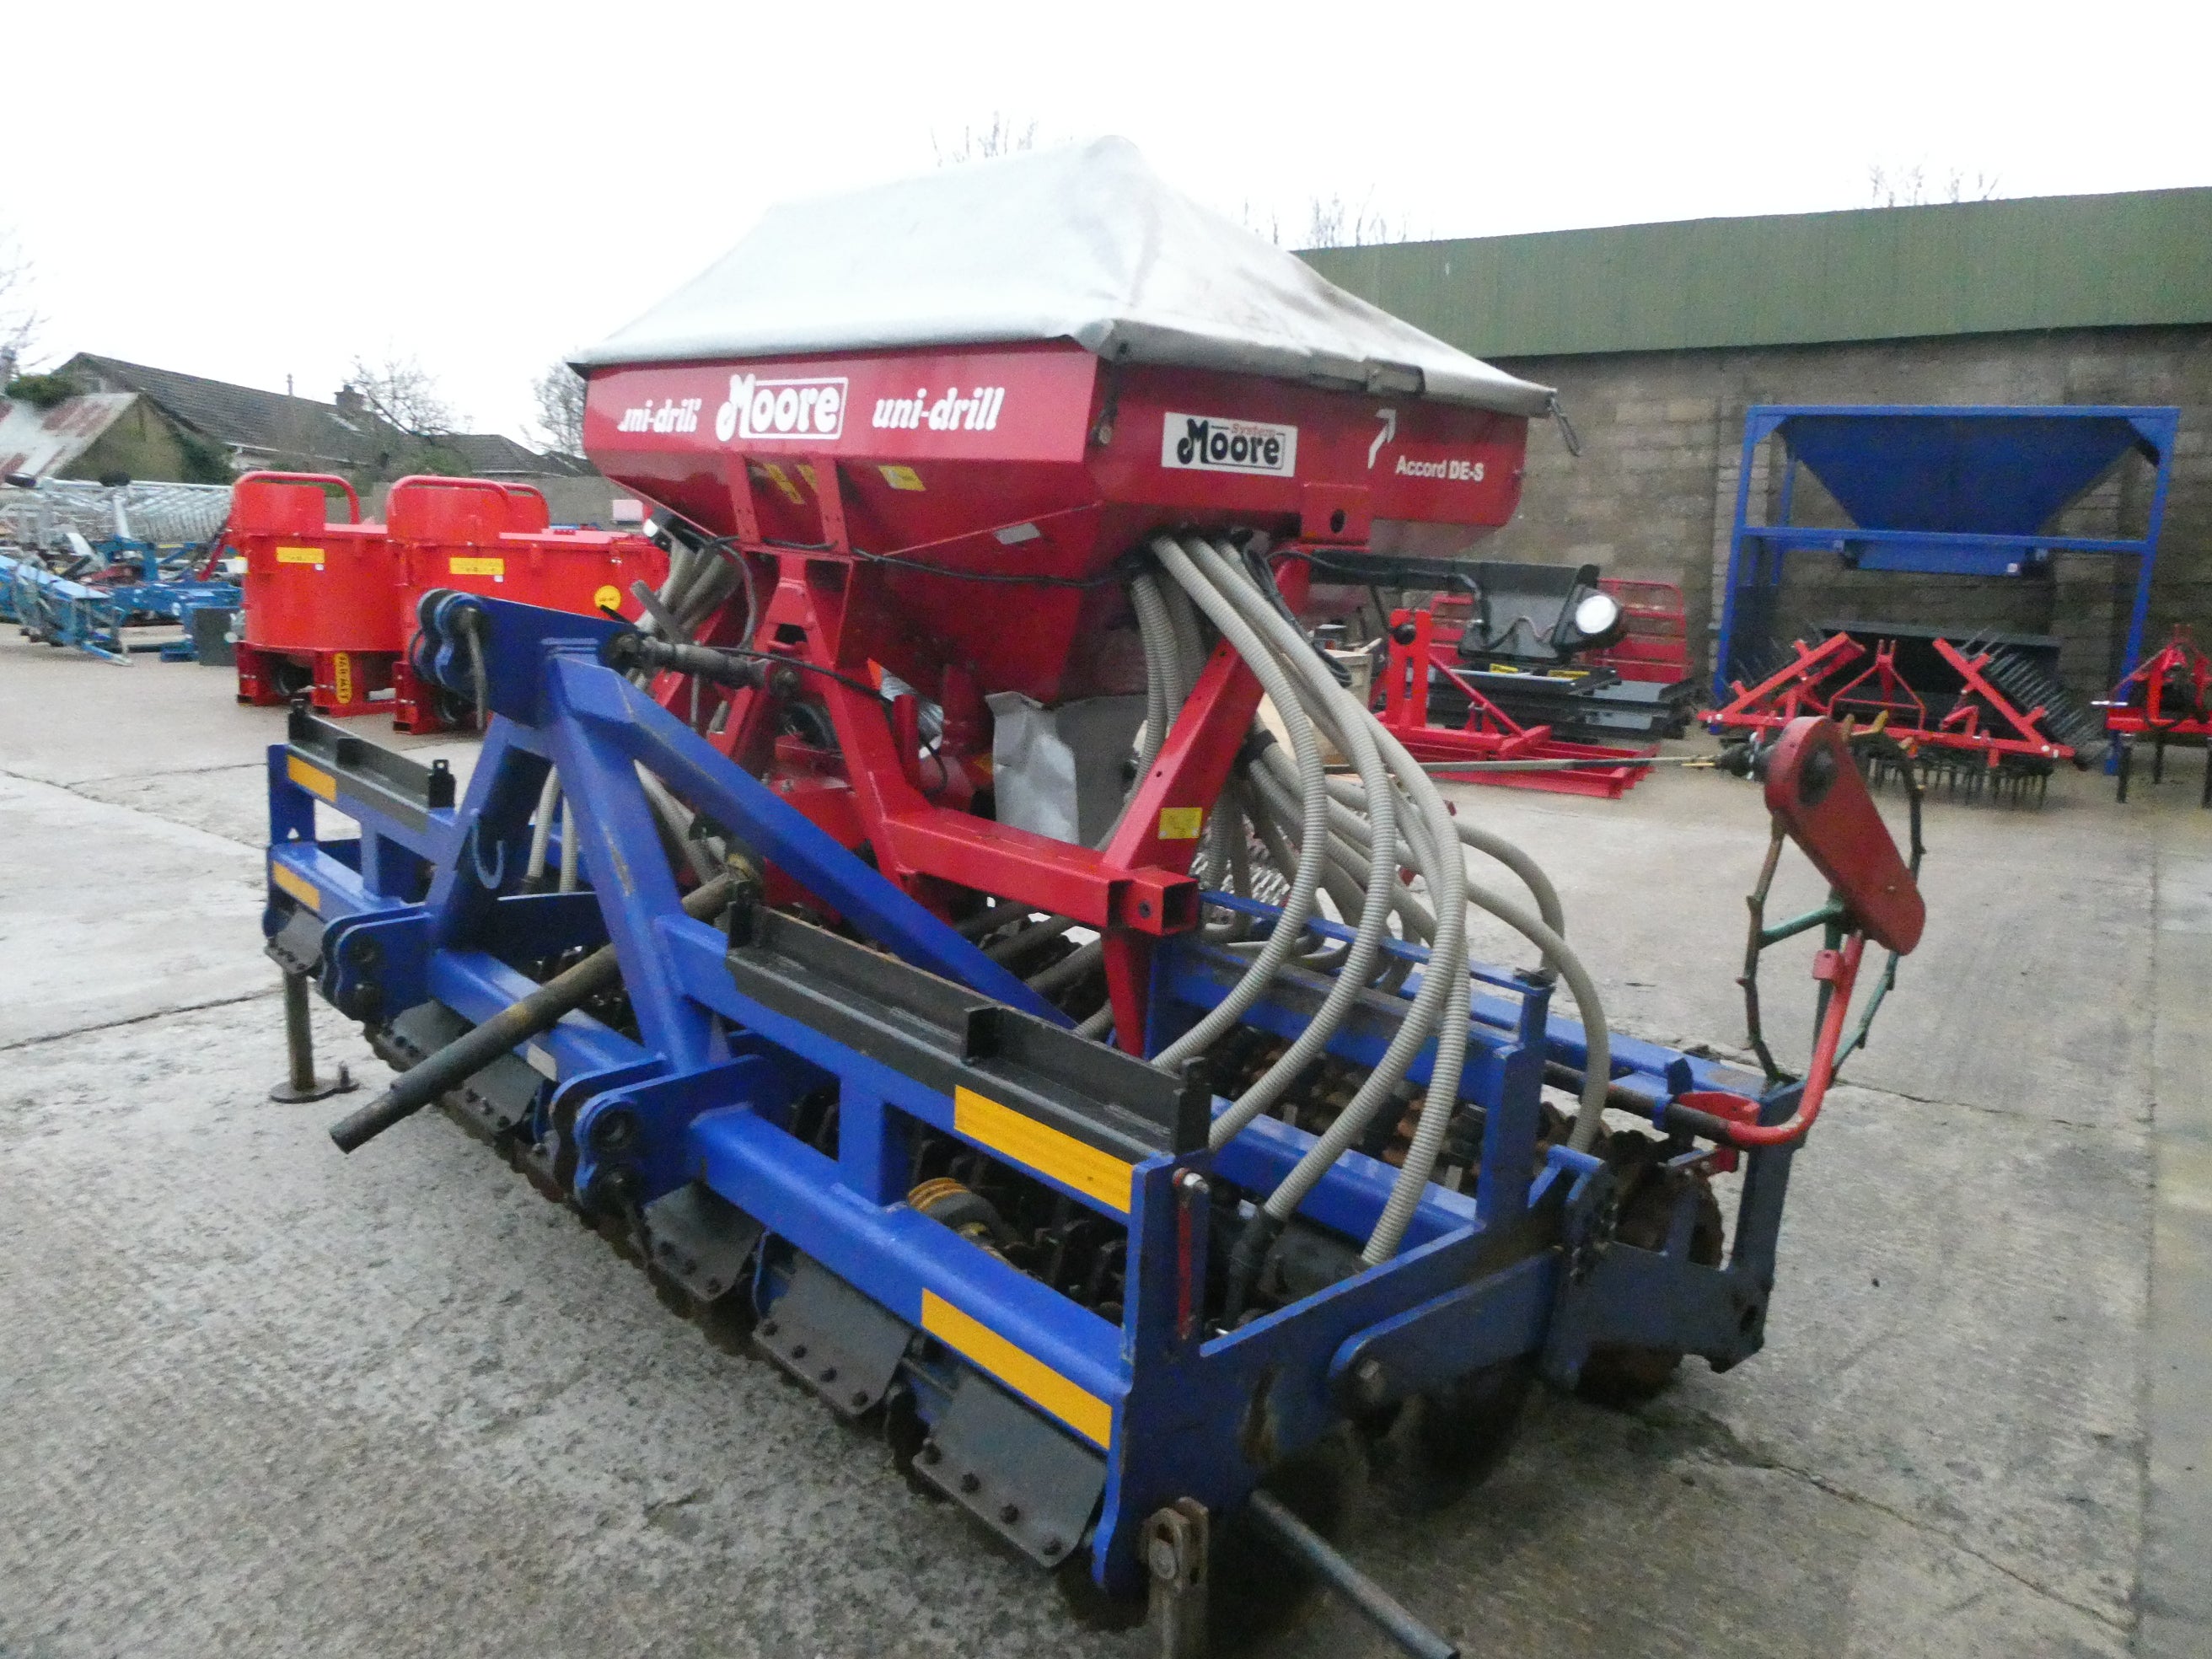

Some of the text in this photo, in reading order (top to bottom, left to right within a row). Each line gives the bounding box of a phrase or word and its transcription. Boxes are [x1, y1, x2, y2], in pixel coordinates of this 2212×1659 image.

[716, 373, 841, 442] Moore
[872, 387, 1006, 431] uni-drill
[1177, 418, 1280, 465] Moore
[1395, 455, 1484, 481] Accord DE-S
